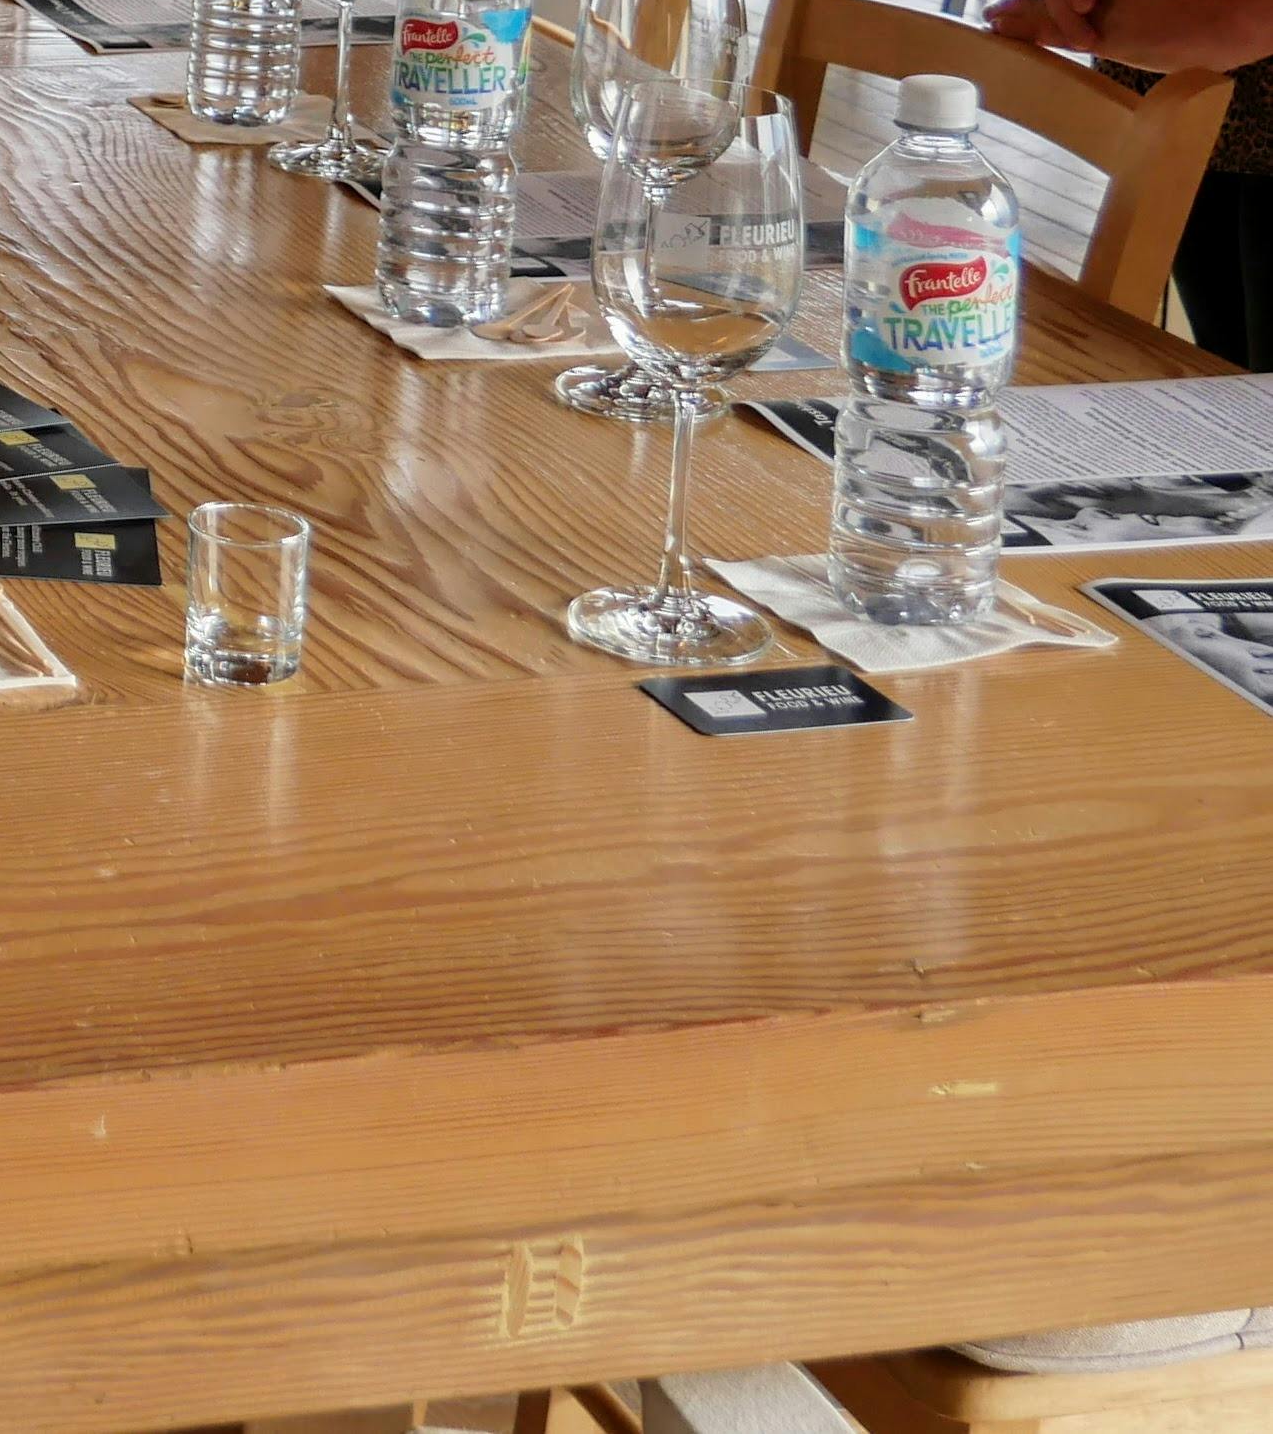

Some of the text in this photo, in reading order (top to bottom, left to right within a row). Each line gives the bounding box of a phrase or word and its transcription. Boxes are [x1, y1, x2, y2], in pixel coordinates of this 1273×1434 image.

[720, 218, 795, 246] FLEURIEU
[752, 684, 851, 702] FLEURIEU
[766, 695, 864, 711] FOOD & WINE
